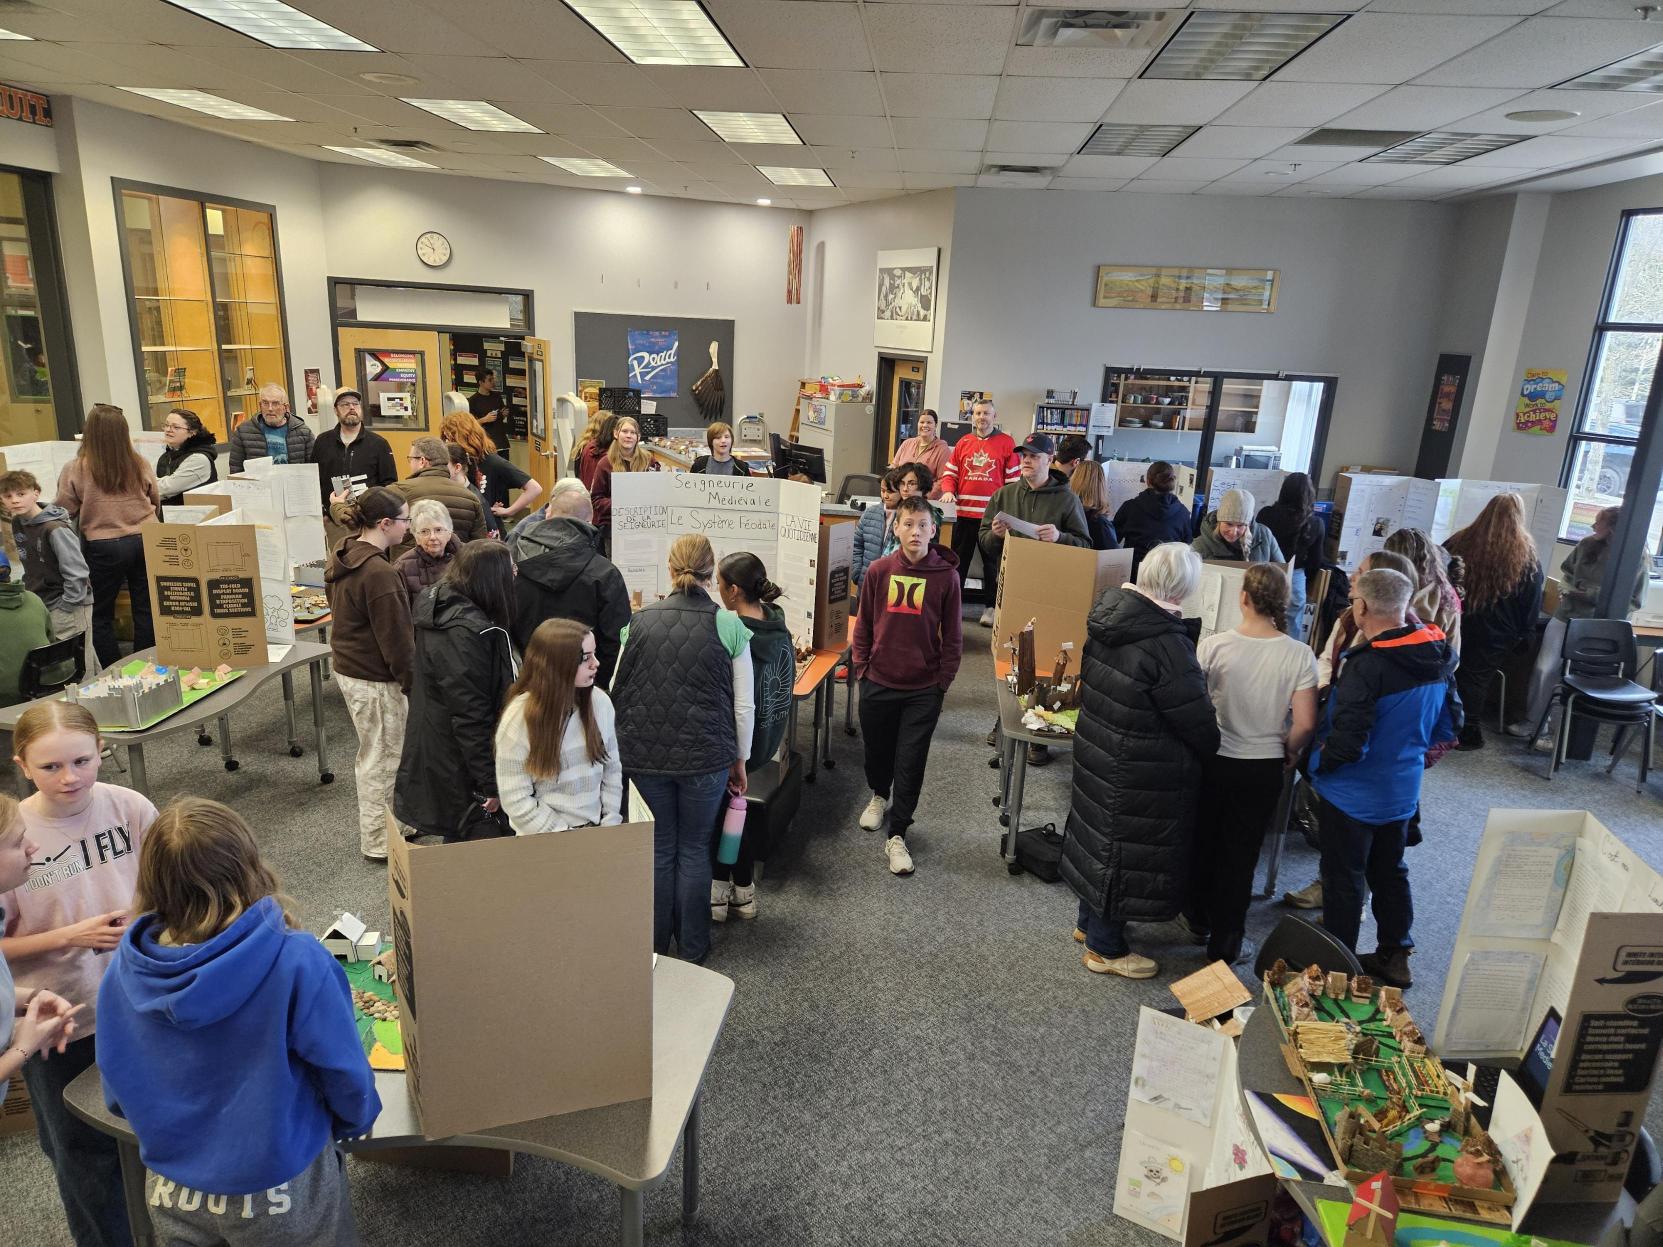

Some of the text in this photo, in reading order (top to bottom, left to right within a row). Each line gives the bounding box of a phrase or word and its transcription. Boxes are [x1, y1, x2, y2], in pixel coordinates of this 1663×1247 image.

[628, 341, 678, 383] Read
[1523, 382, 1559, 395] Dream
[1517, 411, 1556, 423] Achieve
[674, 473, 757, 492] Seigneurie
[612, 505, 667, 516] DESCRIPTION
[626, 515, 637, 523] DE
[670, 509, 777, 533] Le Système Féodale
[785, 514, 813, 532] LA VIE
[80, 822, 134, 870] I FLY
